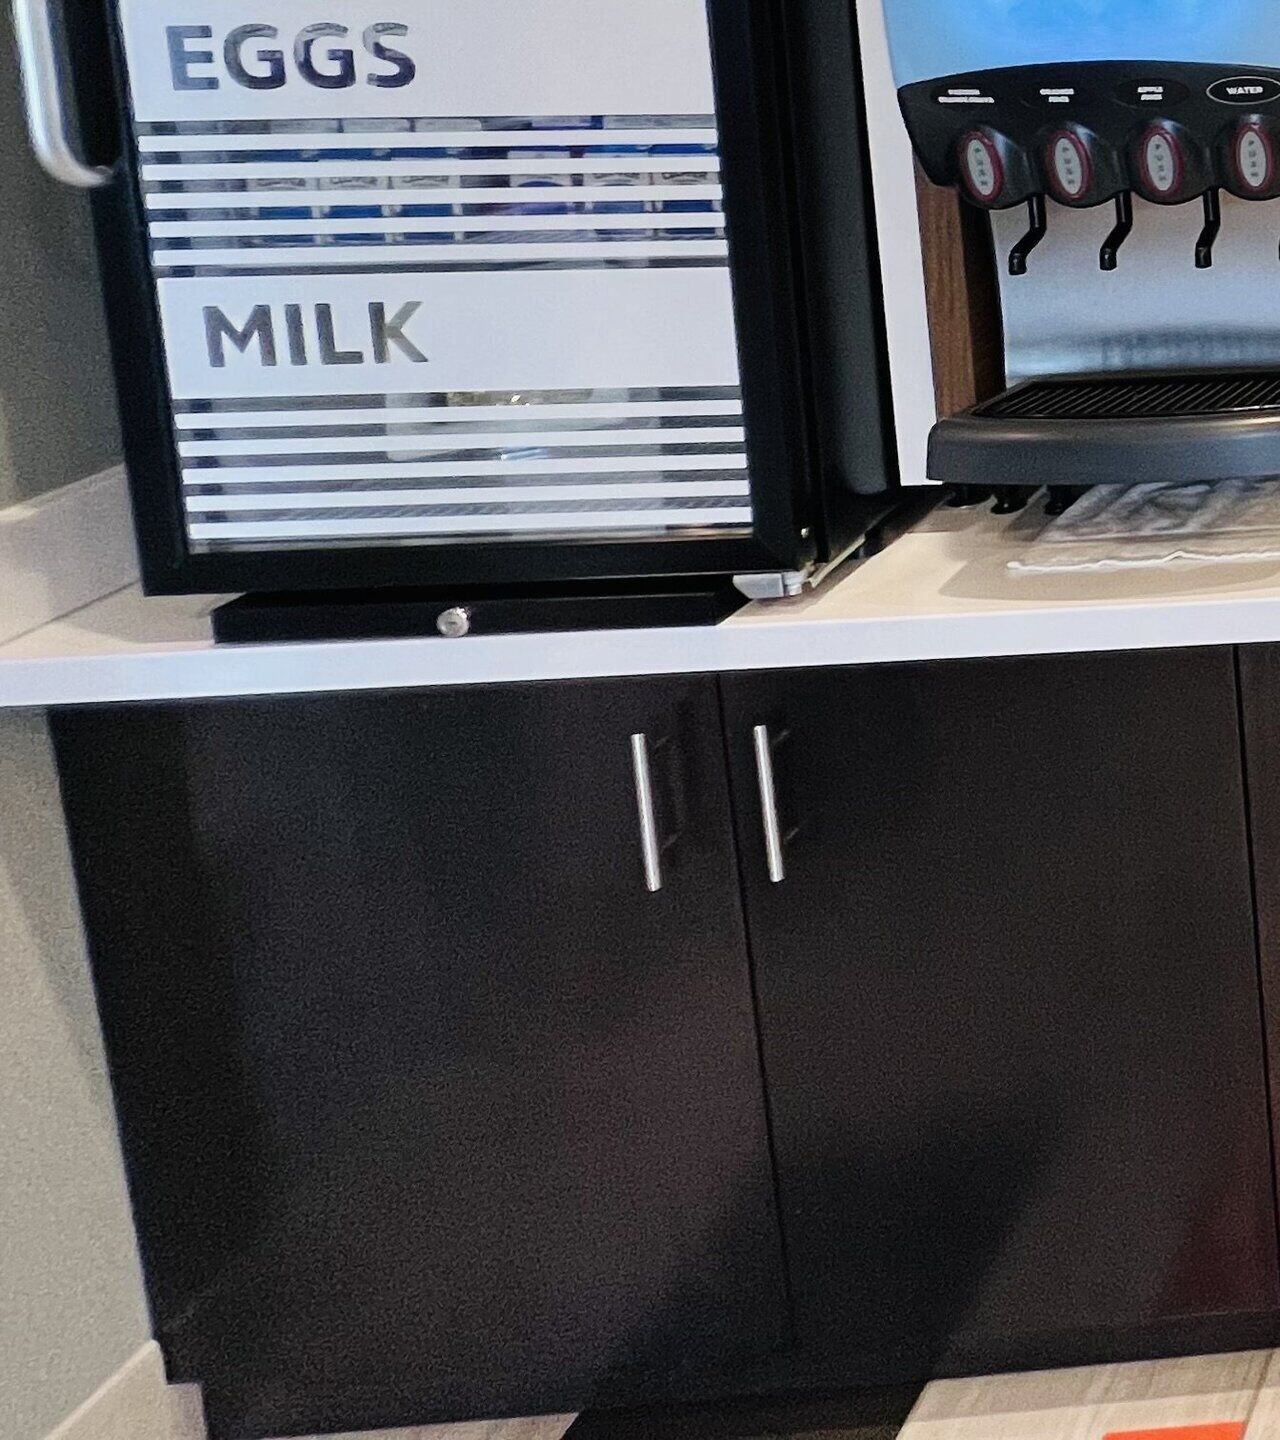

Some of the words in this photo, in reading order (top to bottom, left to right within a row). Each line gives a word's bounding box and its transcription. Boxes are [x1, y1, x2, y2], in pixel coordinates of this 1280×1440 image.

[164, 21, 417, 91] EGGS
[1225, 86, 1264, 95] WATER
[202, 300, 430, 368] MILK
